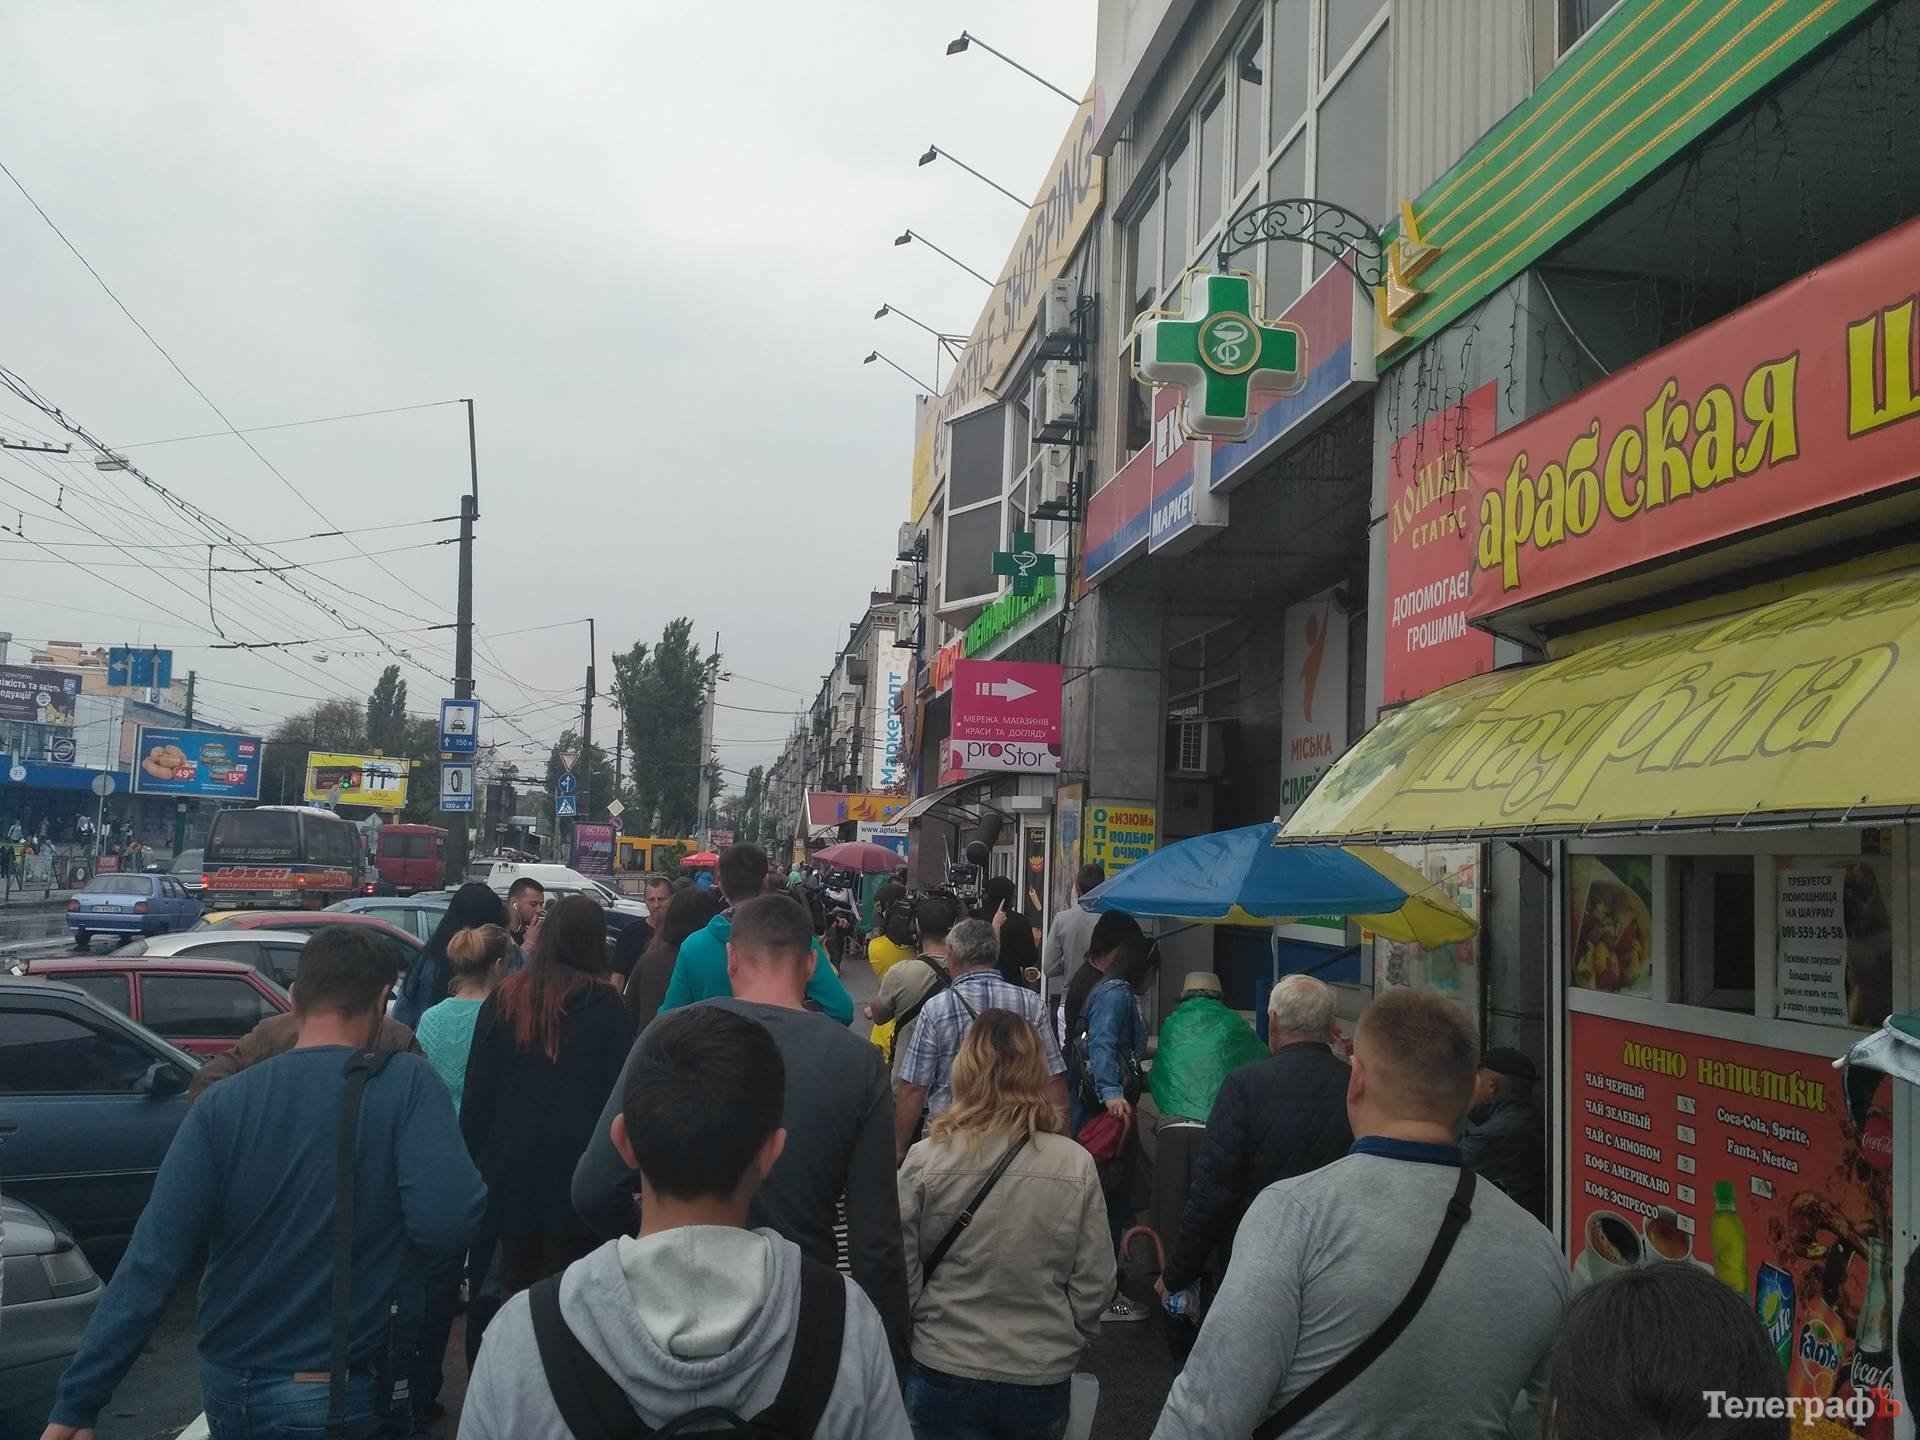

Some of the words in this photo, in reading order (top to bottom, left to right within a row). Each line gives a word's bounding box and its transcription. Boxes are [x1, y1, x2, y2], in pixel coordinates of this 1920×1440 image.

[1003, 115, 1092, 345] SHOPPING
[1152, 485, 1194, 539] МАРКЕТ
[1393, 449, 1470, 545] ЛОМБА
[1412, 505, 1467, 549] СТАТУС
[1392, 570, 1469, 628] ДОПОМОГАЄ
[1407, 611, 1468, 653] ГРОШИМА
[963, 714, 1000, 725] МЕРЕЖА
[1002, 715, 1049, 727] МАГАЗИНІВ
[965, 726, 992, 737] КРАСИ
[995, 727, 1006, 737] ТА
[1008, 727, 1047, 739] ДОГЛЯДУ
[967, 741, 1047, 767] proStor
[1290, 732, 1334, 762] МІСЬКА
[1109, 812, 1154, 827] «ИЗЮМ»
[1109, 831, 1154, 845] ПОДБОР
[1782, 891, 1838, 903] ПОМОЩНИЦА
[1788, 875, 1832, 887] ТРЕБУЕТСЯ
[1786, 907, 1797, 918] НА
[1798, 907, 1836, 918] ШАУРМУ
[1586, 1072, 1604, 1087] ЧАЙ
[1605, 1077, 1645, 1100] ЧЕРНЫЙ
[1586, 1099, 1604, 1115] ЧАЙ
[1605, 1106, 1651, 1130] ЗЕЛЕНЫЙ
[1717, 1107, 1769, 1136] Coca-Cola,
[1772, 1121, 1810, 1148] Sprite,
[1586, 1126, 1604, 1142] ЧАЙ
[1605, 1133, 1612, 1146] С
[1613, 1136, 1661, 1162] ЛИМОНОМ
[1727, 1138, 1760, 1163] Fanta,
[1762, 1149, 1798, 1172] Nestea
[1586, 1154, 1610, 1173] КОФЕ
[1611, 1162, 1670, 1194] АМЕРИКАНО
[1586, 1181, 1610, 1201] КОФЕ
[1611, 1193, 1659, 1218] ЭСПРЕССО
